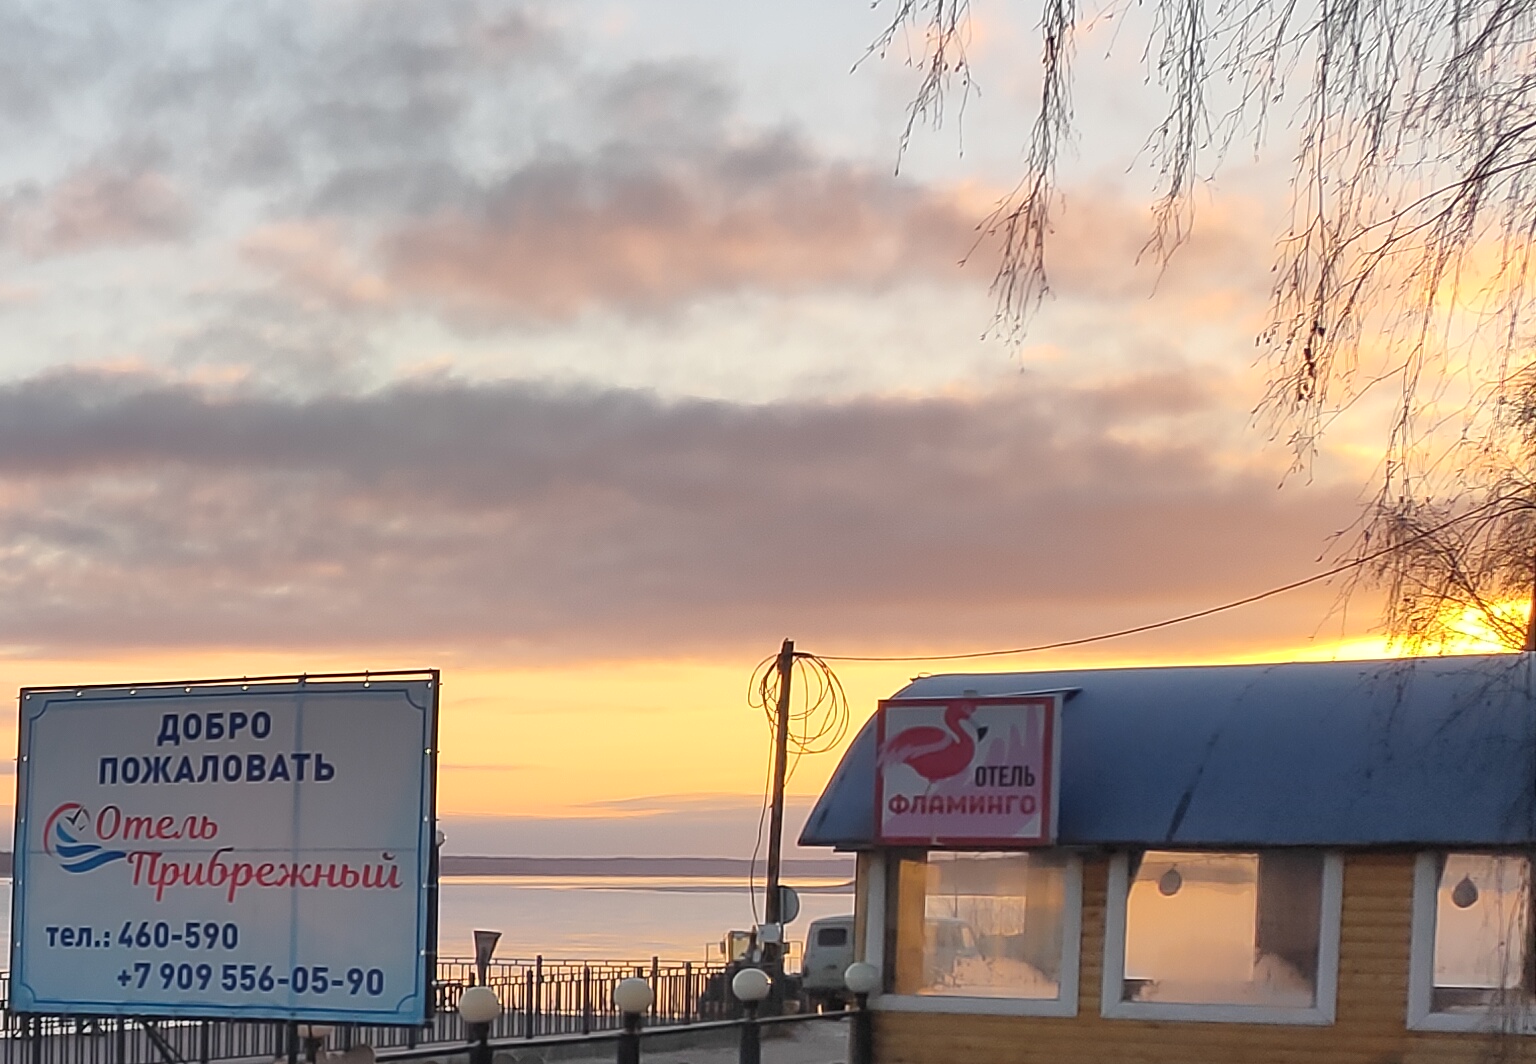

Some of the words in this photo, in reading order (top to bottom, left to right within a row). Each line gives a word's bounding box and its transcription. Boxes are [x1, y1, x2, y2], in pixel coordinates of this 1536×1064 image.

[157, 711, 271, 746] ДОБРО
[99, 752, 335, 784] ПОЖАЛОВАТЬ
[975, 765, 1035, 787] ОТЕЛЬ
[888, 794, 1036, 815] ФЛАМИНГО
[96, 804, 218, 840] Отель
[127, 847, 403, 902] Прибрежный
[46, 925, 111, 949] тел.:
[118, 922, 238, 949] 460-590
[117, 963, 152, 990] +7
[159, 963, 212, 991] 909
[221, 965, 384, 995] 556-05-90
